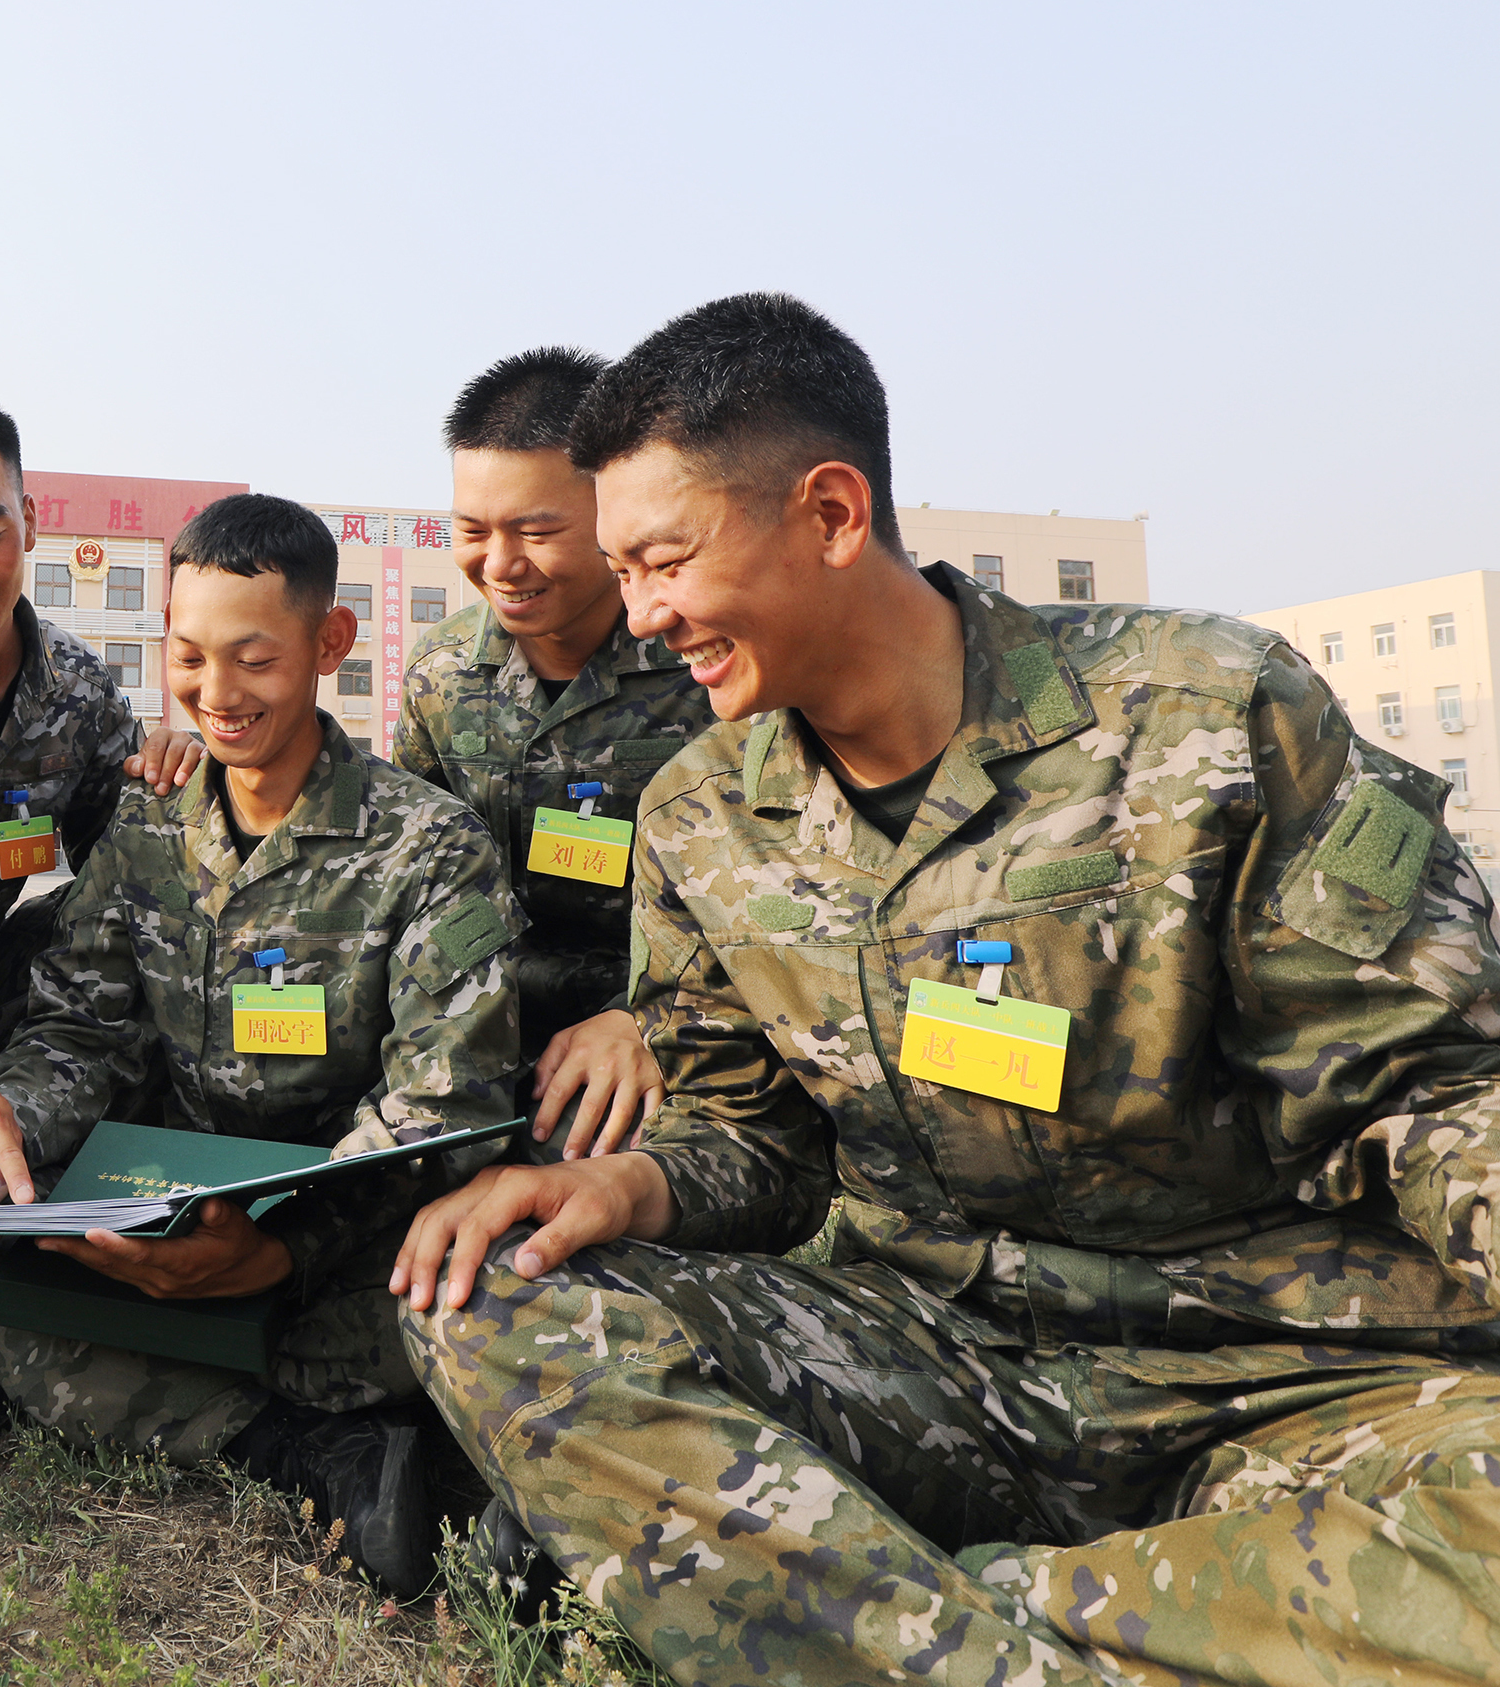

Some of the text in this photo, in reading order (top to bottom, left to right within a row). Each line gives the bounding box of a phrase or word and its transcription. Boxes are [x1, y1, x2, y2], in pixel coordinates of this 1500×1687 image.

[341, 514, 443, 548] 风优
[385, 568, 400, 636] 聚焦实战
[385, 643, 400, 711] 枕戈待旦
[549, 842, 607, 874] 刘涛
[246, 1019, 314, 1045] 周沁宇
[920, 1031, 1039, 1090] 赵一凡
